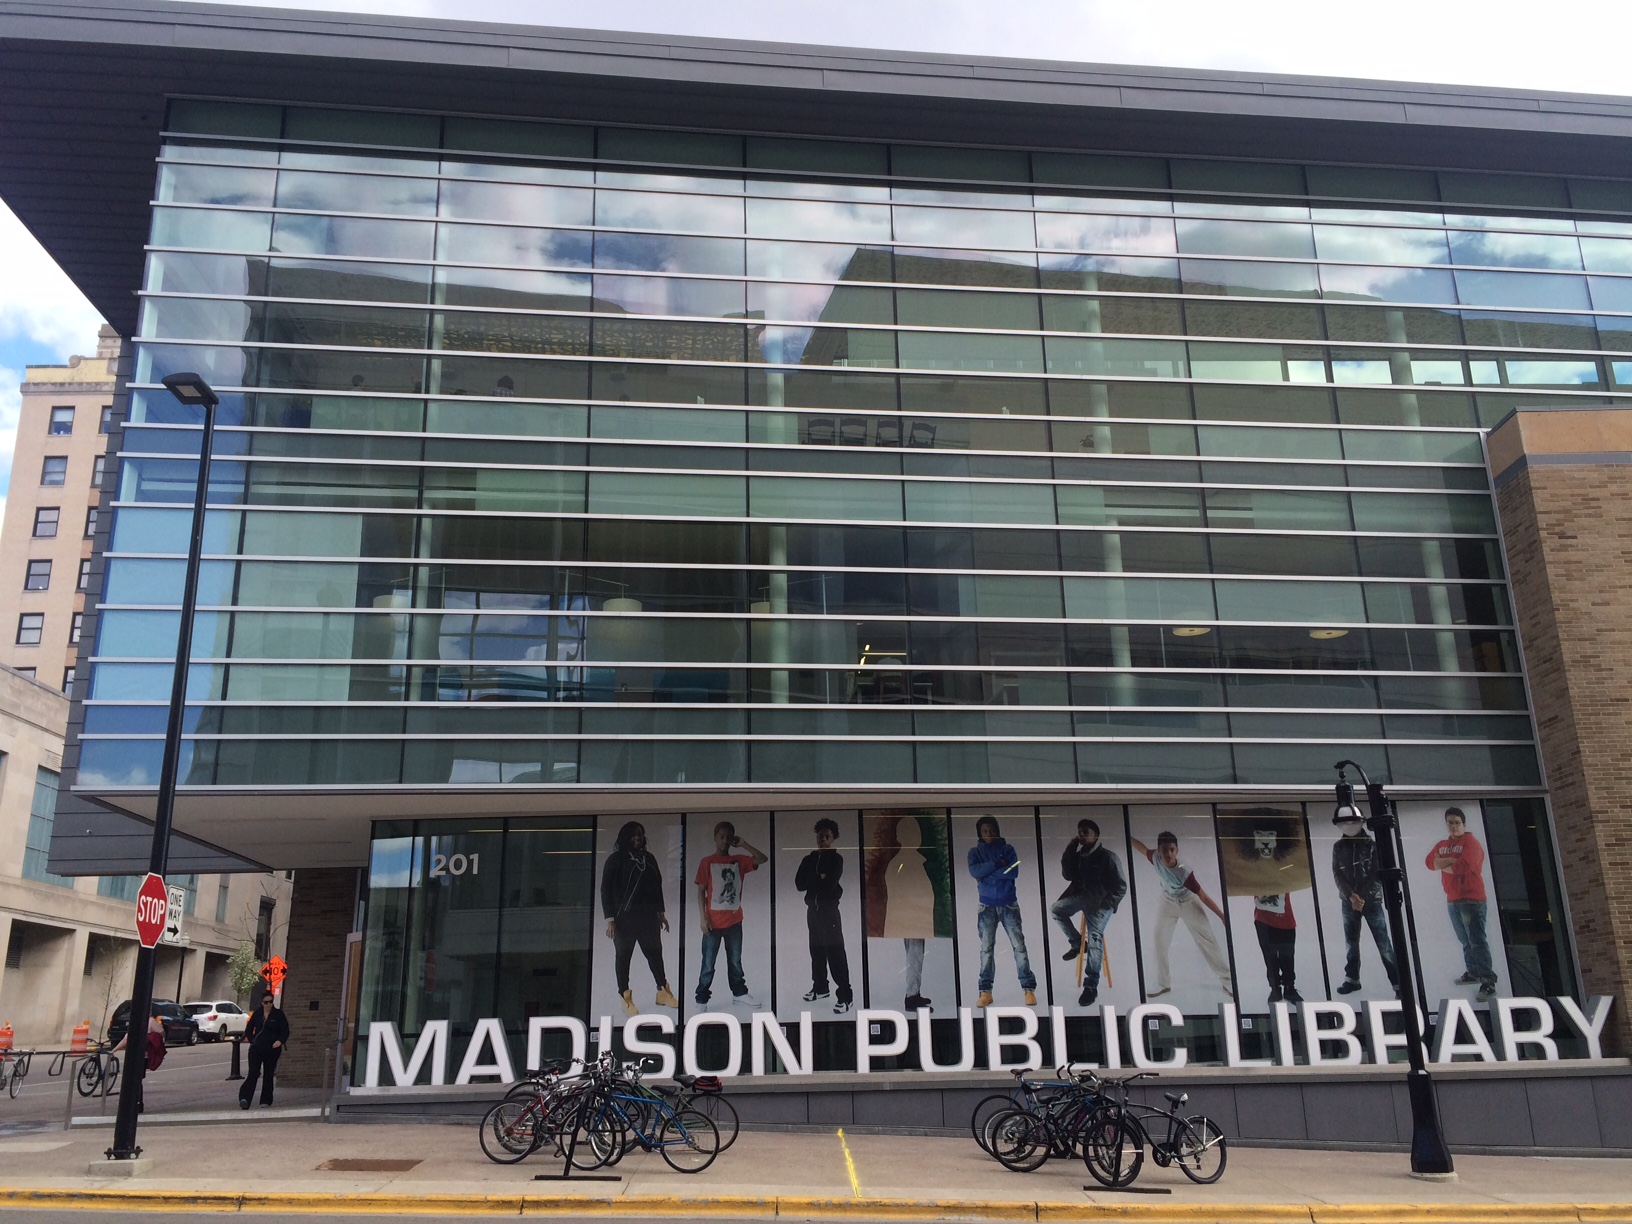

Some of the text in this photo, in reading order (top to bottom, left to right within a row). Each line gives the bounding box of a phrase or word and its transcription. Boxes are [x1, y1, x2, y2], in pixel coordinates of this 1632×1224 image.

[432, 853, 479, 876] 201
[138, 895, 166, 925] STOP
[169, 892, 183, 908] ONE
[168, 908, 181, 922] WAY
[365, 995, 1616, 1088] MADISON PUBLIC LIBRARY
